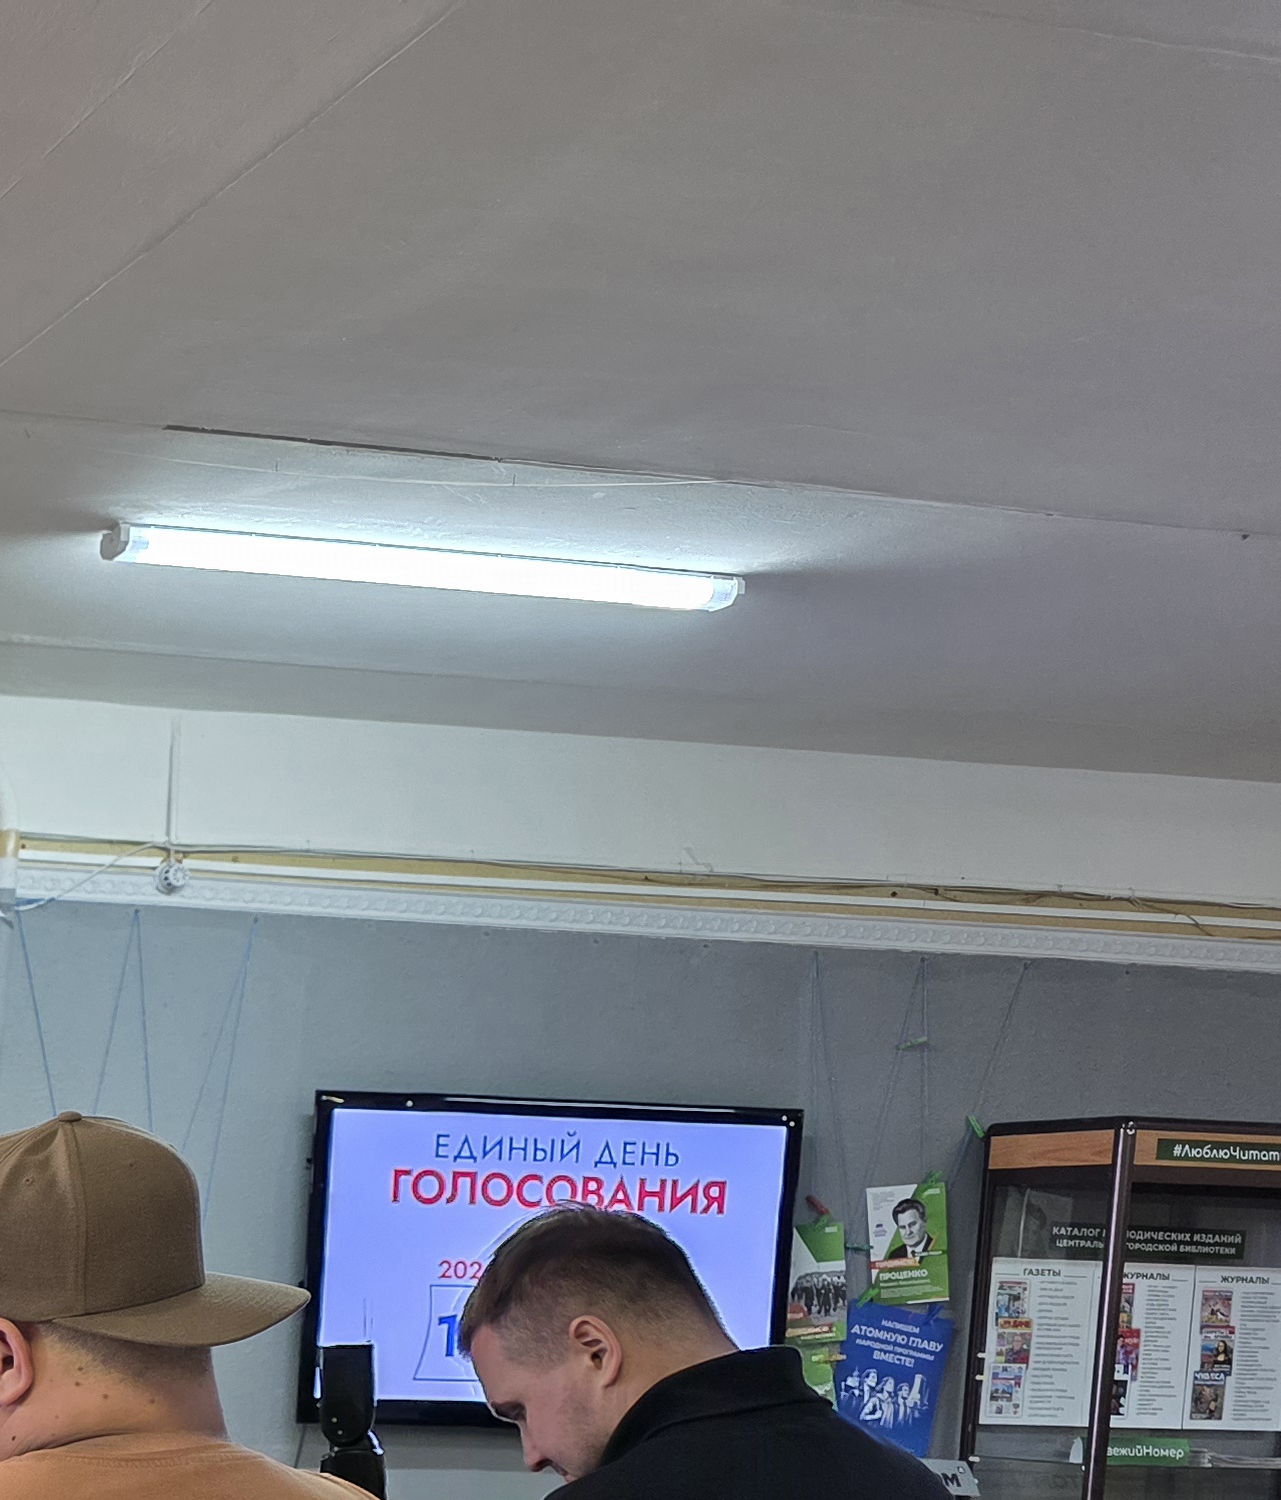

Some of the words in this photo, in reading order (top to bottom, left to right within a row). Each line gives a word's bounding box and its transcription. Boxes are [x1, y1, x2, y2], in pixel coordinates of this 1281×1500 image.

[435, 1130, 581, 1164] ЕДИНЫЙ
[594, 1139, 680, 1169] ДЕНЬ
[1173, 1144, 1280, 1162] #ЛюблюЧитат
[390, 1168, 727, 1215] ГОЛОСОВАНИЯ
[1052, 1226, 1100, 1237] КАТАЛОГ
[1102, 1229, 1191, 1242] ОДИЧЕСКИХ
[1193, 1233, 1242, 1244] ИЗДАНИЙ
[1056, 1239, 1104, 1249] ЦЕНТРАЛЬ
[1179, 1244, 1236, 1255] БИБЛИОТЕКИ
[438, 1260, 483, 1280] 202
[879, 1269, 928, 1281] ПРОЦЕНКО
[1023, 1268, 1061, 1277] ГАЗЕТЫ
[1221, 1275, 1270, 1285] ЖУРНАЛЫ
[438, 1314, 458, 1357] 1
[851, 1324, 907, 1345] АТОМНУЮ
[908, 1336, 944, 1352] ГЛАВУ
[873, 1350, 915, 1368] ВМЕСТЕ!
[1106, 1444, 1185, 1461] вежийНомер
